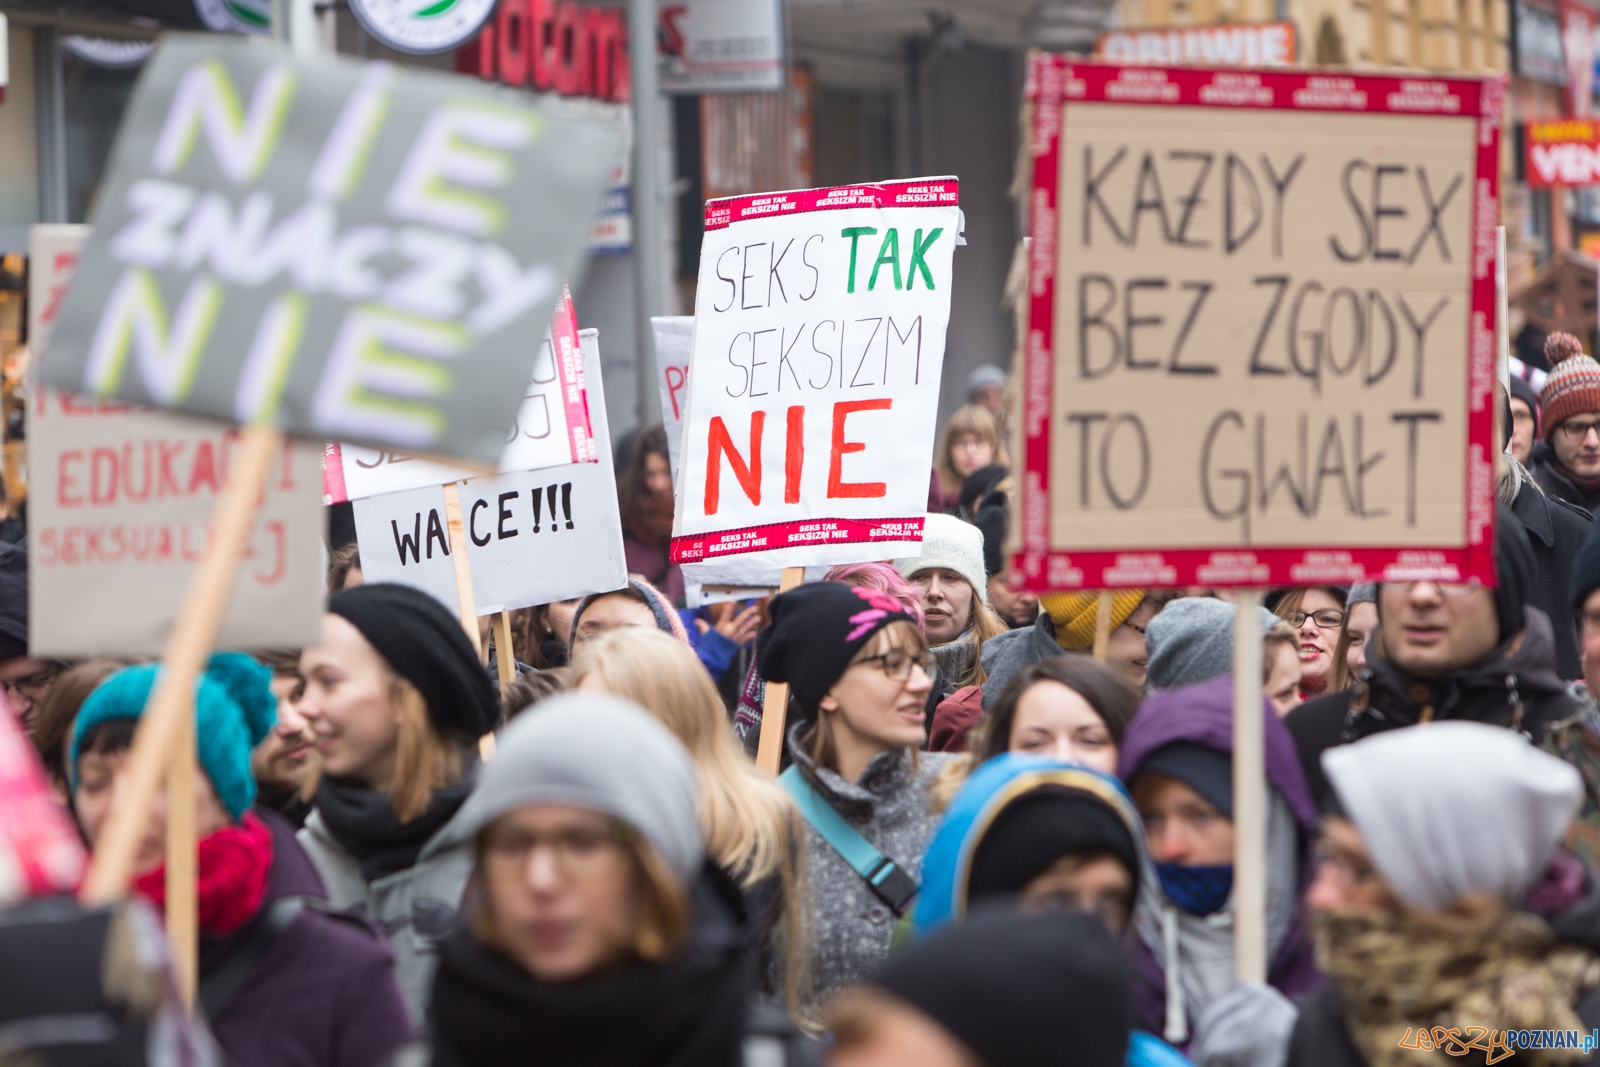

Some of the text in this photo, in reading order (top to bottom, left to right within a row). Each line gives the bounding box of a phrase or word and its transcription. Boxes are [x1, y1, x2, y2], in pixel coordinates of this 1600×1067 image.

[152, 60, 542, 237] NIE
[741, 202, 797, 216] SEKSIZM NIE
[752, 196, 788, 206] SEKS TAK
[816, 195, 875, 207] SEKSIZM NIE
[828, 190, 849, 198] SEKS
[895, 192, 957, 203] SEKSIZM NIE
[907, 185, 945, 194] SEKS TAK
[1328, 160, 1464, 265] SEX
[110, 180, 558, 335] ZNACZY
[714, 234, 823, 312] SEKS
[841, 227, 944, 293] TAK
[84, 267, 472, 444] NIE
[726, 315, 922, 397] SEKSIZM
[1079, 275, 1219, 379] BEZ
[1249, 276, 1450, 399] ZGODY
[704, 398, 892, 516] NIE
[1066, 412, 1151, 510] TO
[1203, 410, 1443, 546] GWAŁT
[391, 482, 574, 566] WACE!!!
[709, 537, 767, 553] SEKSIZM NIE
[720, 531, 757, 543] SEKS TAK
[788, 530, 848, 542] SEKSIZM NIE
[799, 525, 820, 533] SEKS
